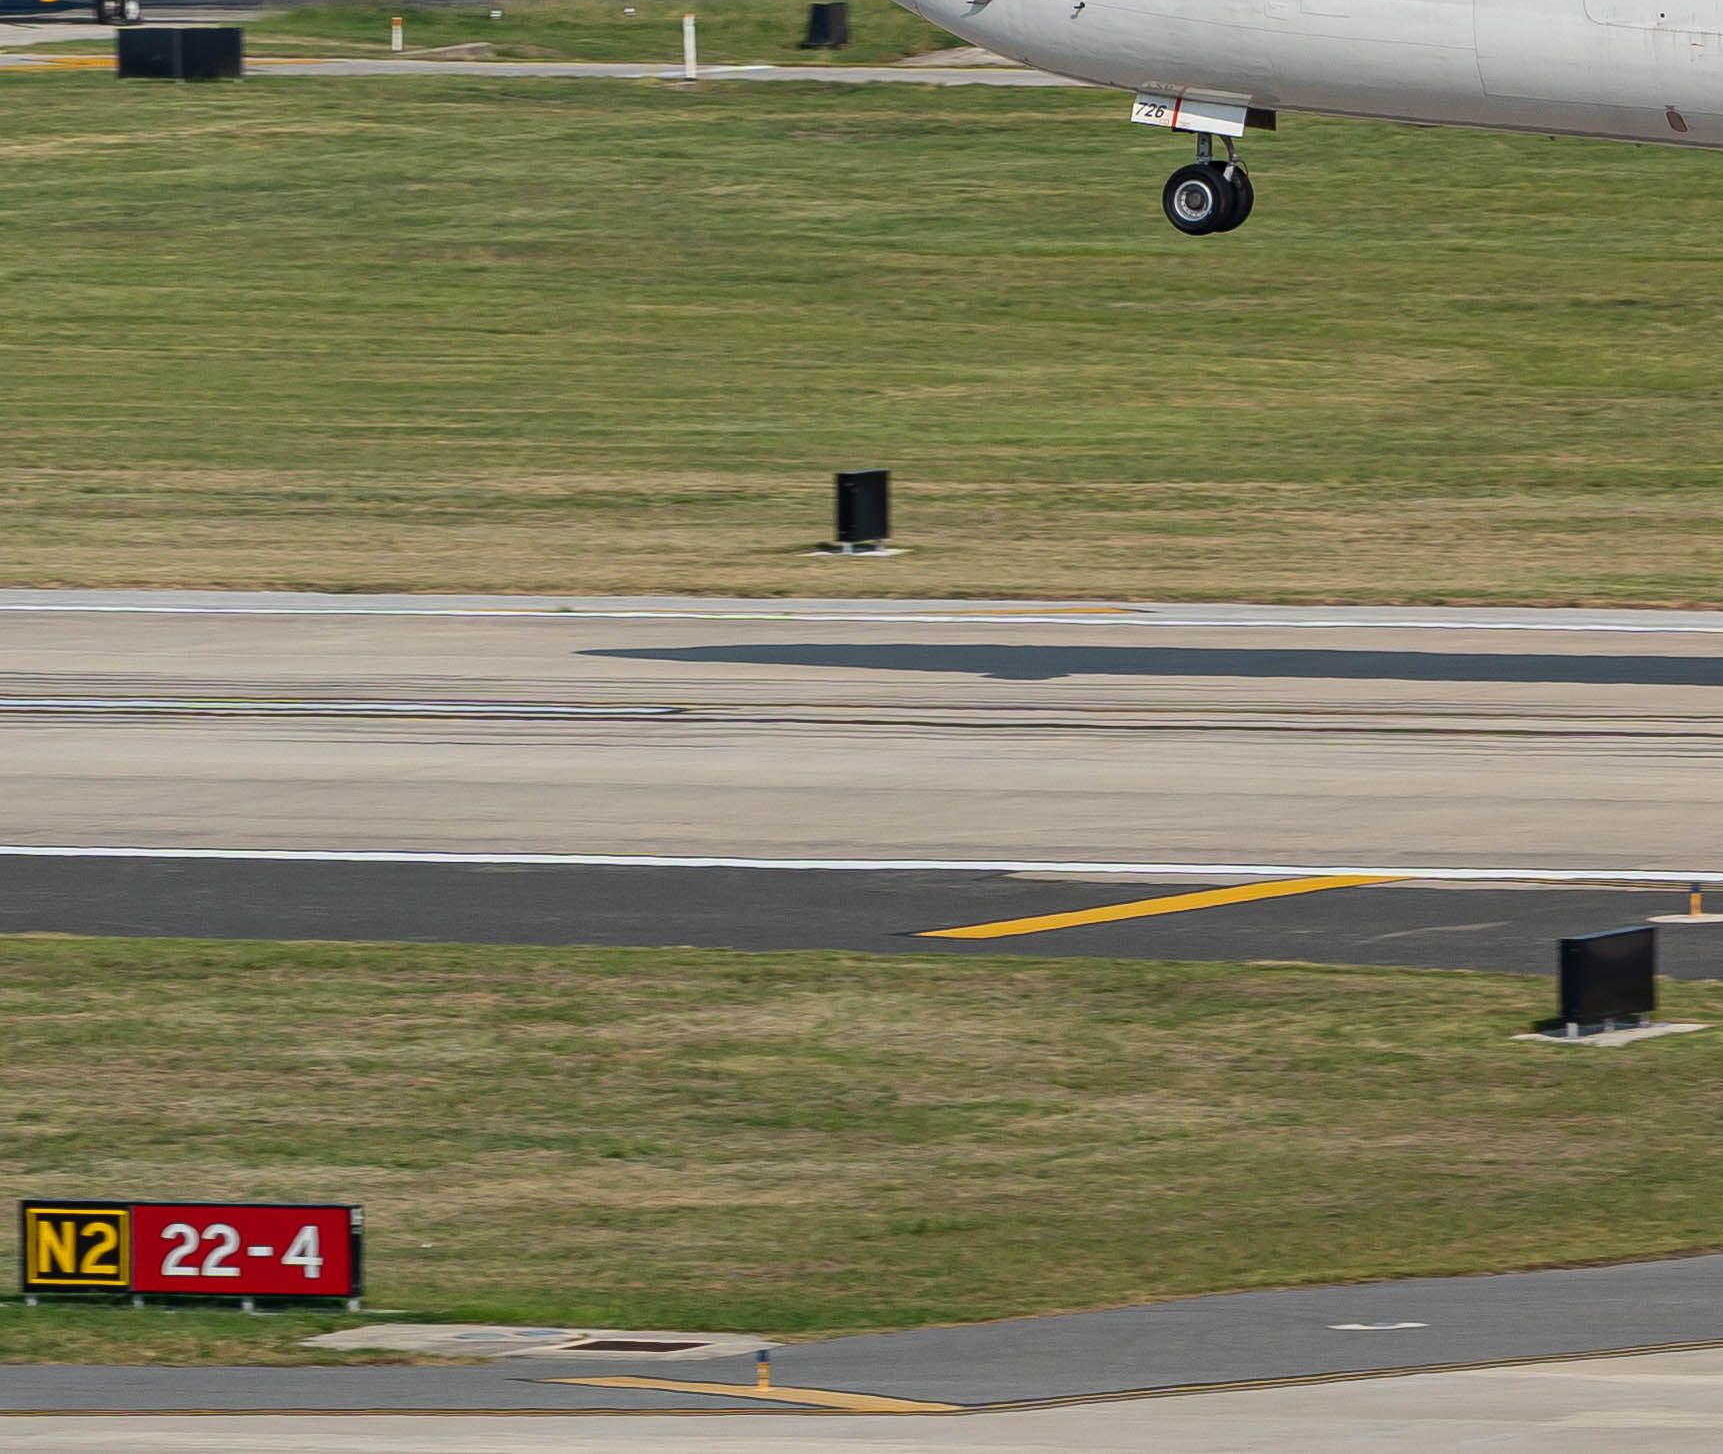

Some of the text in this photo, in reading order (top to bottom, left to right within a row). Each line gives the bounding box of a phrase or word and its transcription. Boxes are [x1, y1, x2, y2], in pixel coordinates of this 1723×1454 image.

[1135, 102, 1168, 119] 726
[37, 1221, 324, 1279] N2 22-4
